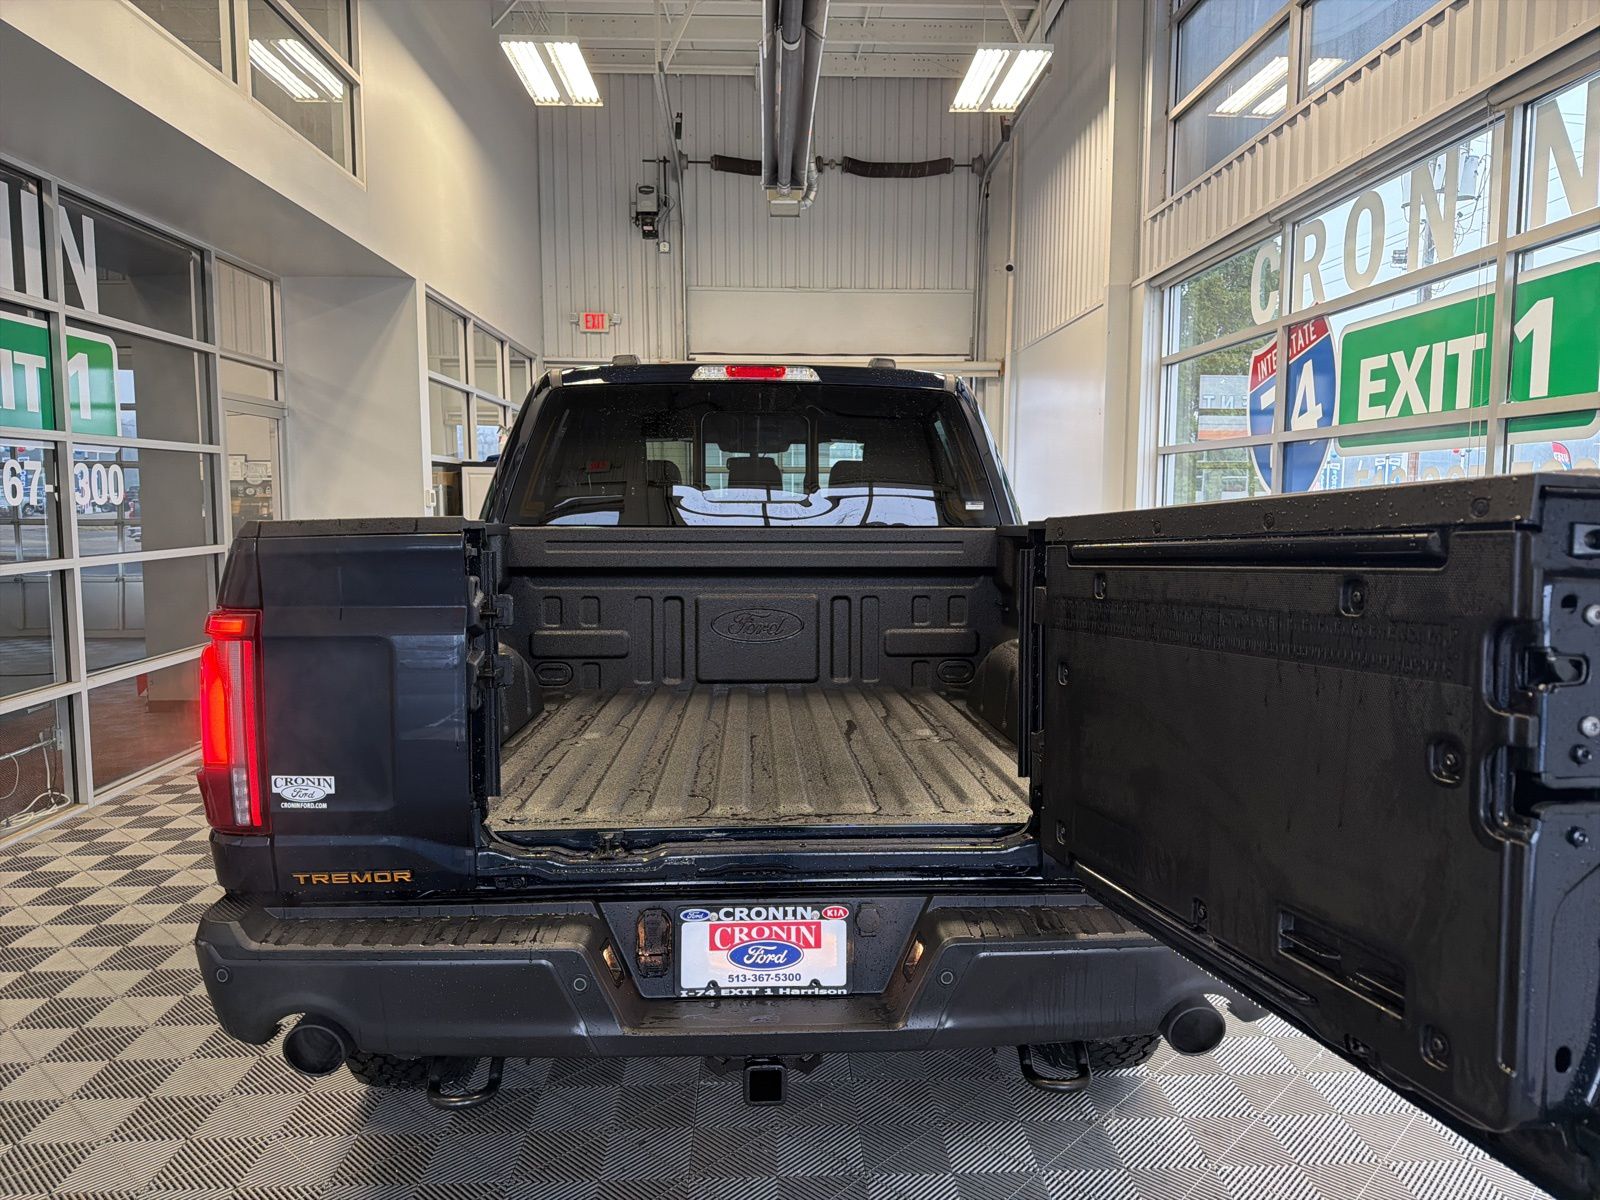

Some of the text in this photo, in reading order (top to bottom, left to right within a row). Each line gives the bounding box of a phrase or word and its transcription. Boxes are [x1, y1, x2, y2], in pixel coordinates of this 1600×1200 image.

[584, 313, 605, 330] EXIT
[1257, 319, 1317, 382] INTETATE
[1357, 297, 1554, 422] EXIT 1
[67, 352, 92, 421] 1
[727, 612, 788, 636] Ford
[273, 776, 333, 790] CRONIN
[290, 787, 316, 799] Ford
[292, 870, 412, 885] TREMOR
[683, 910, 707, 920] Ford
[718, 906, 812, 921] CRONIN
[826, 908, 845, 918] KIA
[714, 924, 816, 950] CRONIN
[743, 945, 787, 965] Ford
[727, 973, 802, 983] 513-367-5300
[680, 987, 848, 997] I-74 EXIT 1 Harrison
